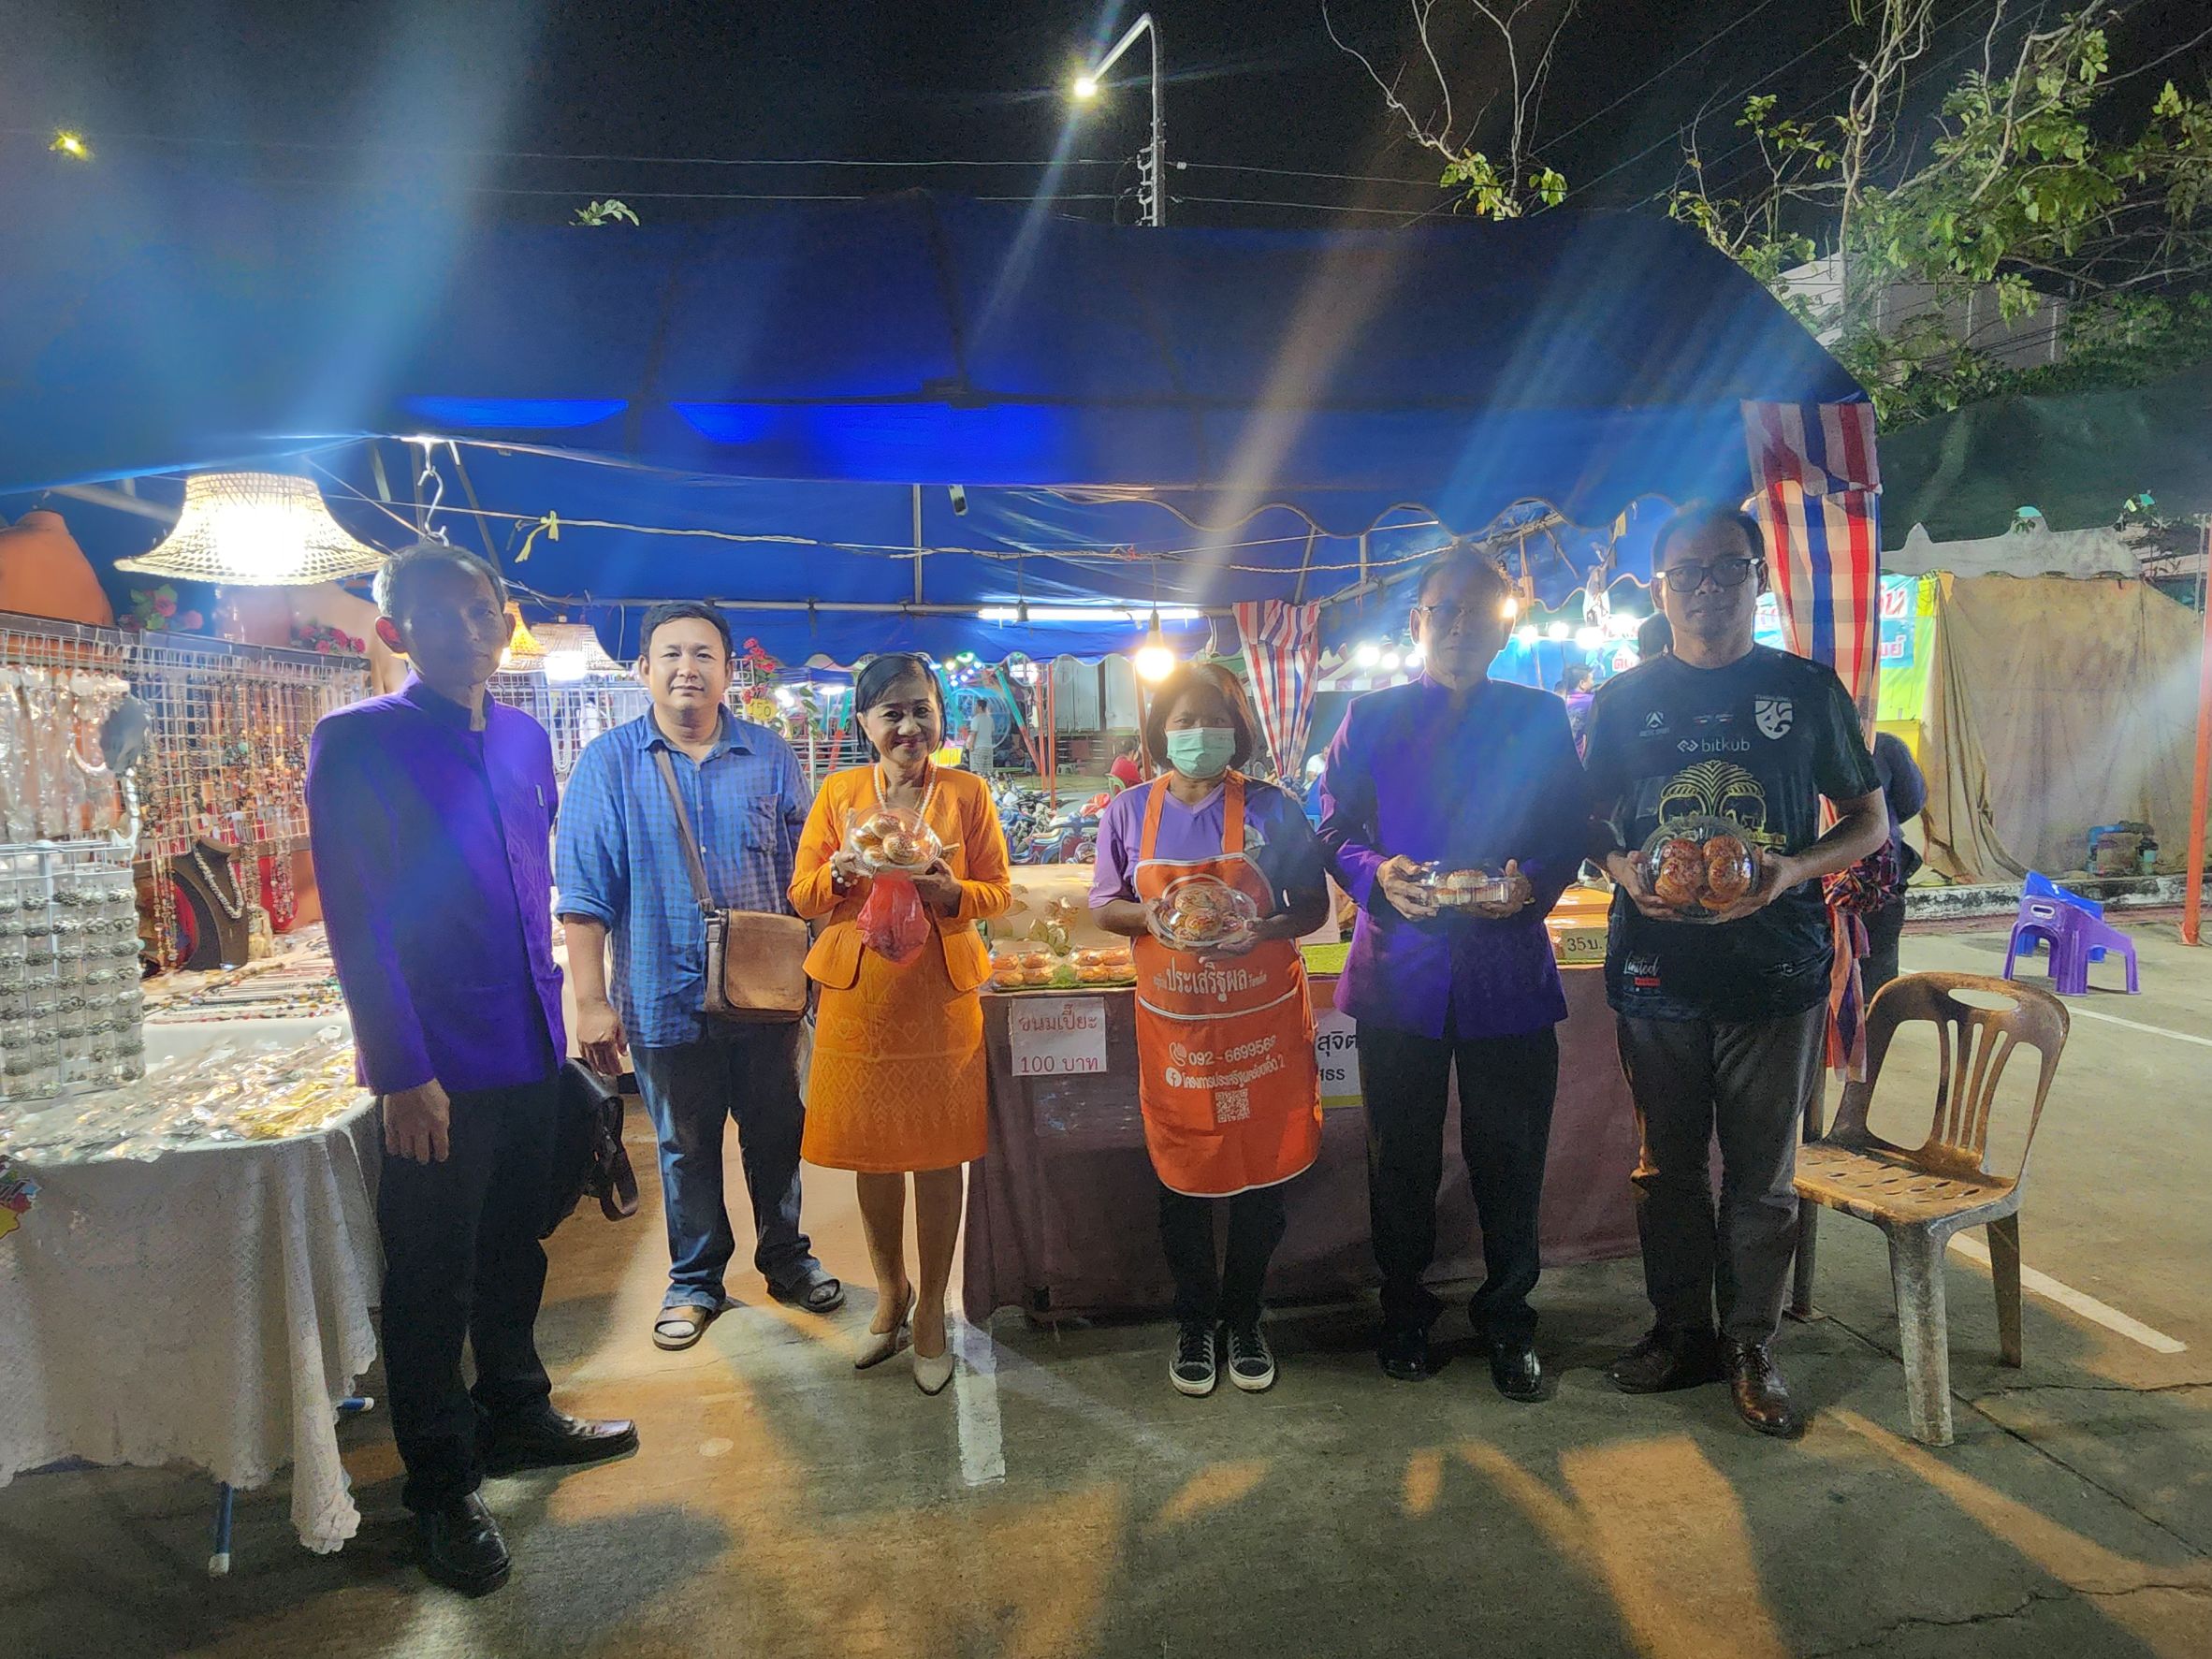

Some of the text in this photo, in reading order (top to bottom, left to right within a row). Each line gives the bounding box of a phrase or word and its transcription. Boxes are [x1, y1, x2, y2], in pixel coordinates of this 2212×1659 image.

[1701, 736, 1751, 752] bitkub
[1166, 955, 1247, 1003] ประเสริฐผล
[1020, 1055, 1099, 1073] 100 บาท
